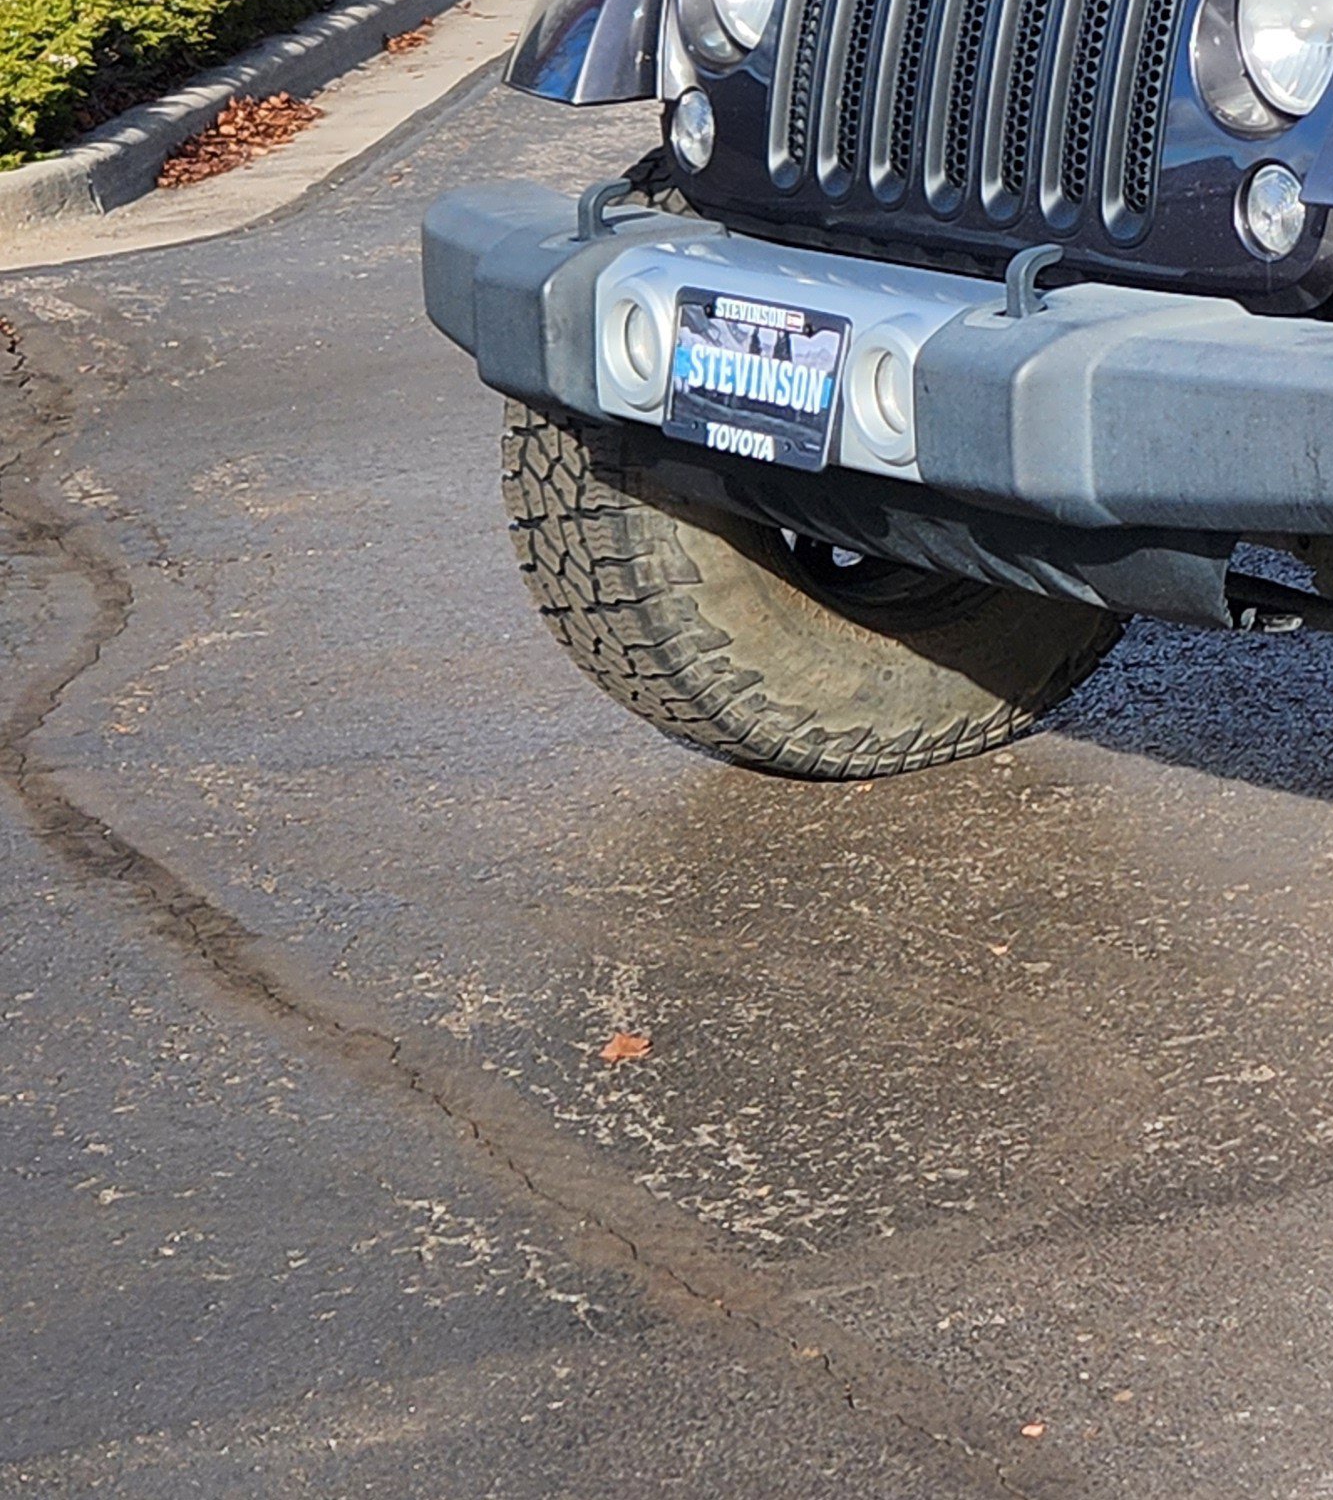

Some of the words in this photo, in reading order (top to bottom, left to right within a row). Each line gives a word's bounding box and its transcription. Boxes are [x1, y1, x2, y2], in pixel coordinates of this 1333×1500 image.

[714, 297, 787, 329] STEVINSON
[687, 343, 828, 414] STEVINSON
[706, 421, 775, 462] TOYOTA
